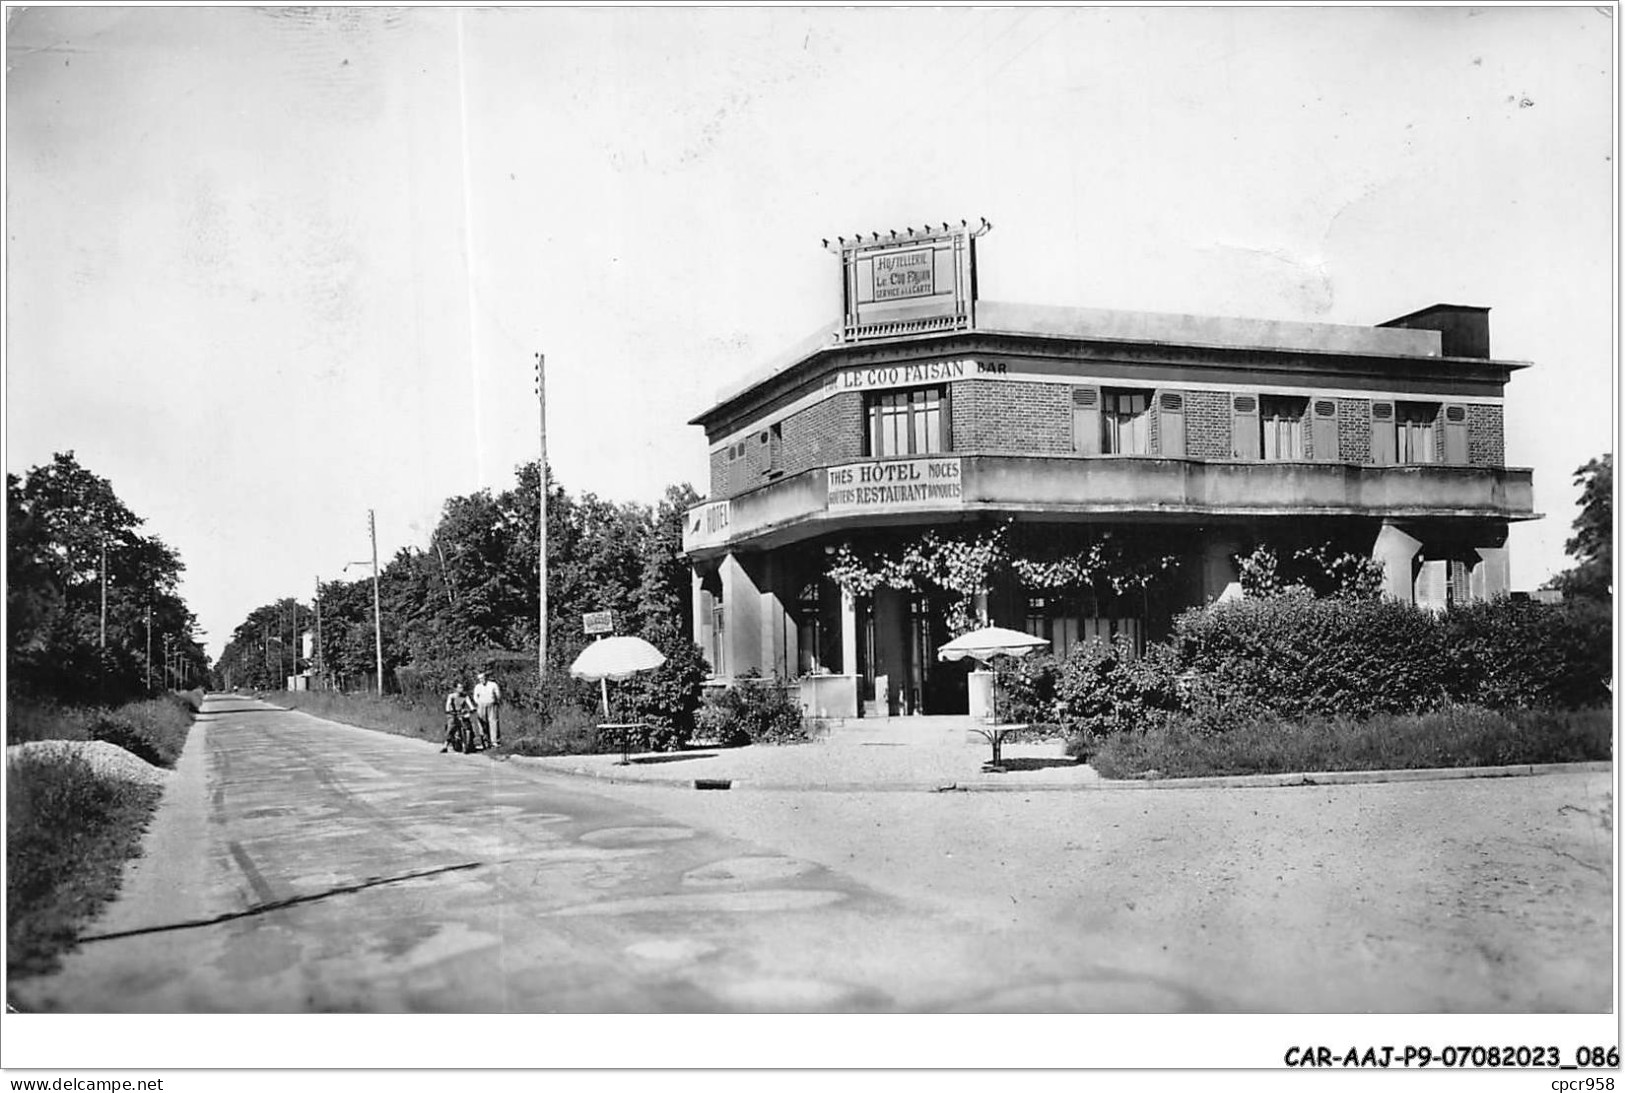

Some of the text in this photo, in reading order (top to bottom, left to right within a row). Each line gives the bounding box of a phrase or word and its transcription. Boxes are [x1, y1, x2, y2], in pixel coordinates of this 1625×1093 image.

[913, 284, 931, 294] CARTE
[844, 370, 863, 387] LE
[867, 368, 898, 385] COQ
[905, 360, 964, 382] FAISAN
[977, 361, 1007, 374] BAR
[928, 463, 959, 478] NOCES
[856, 484, 927, 504] RESTAURANT
